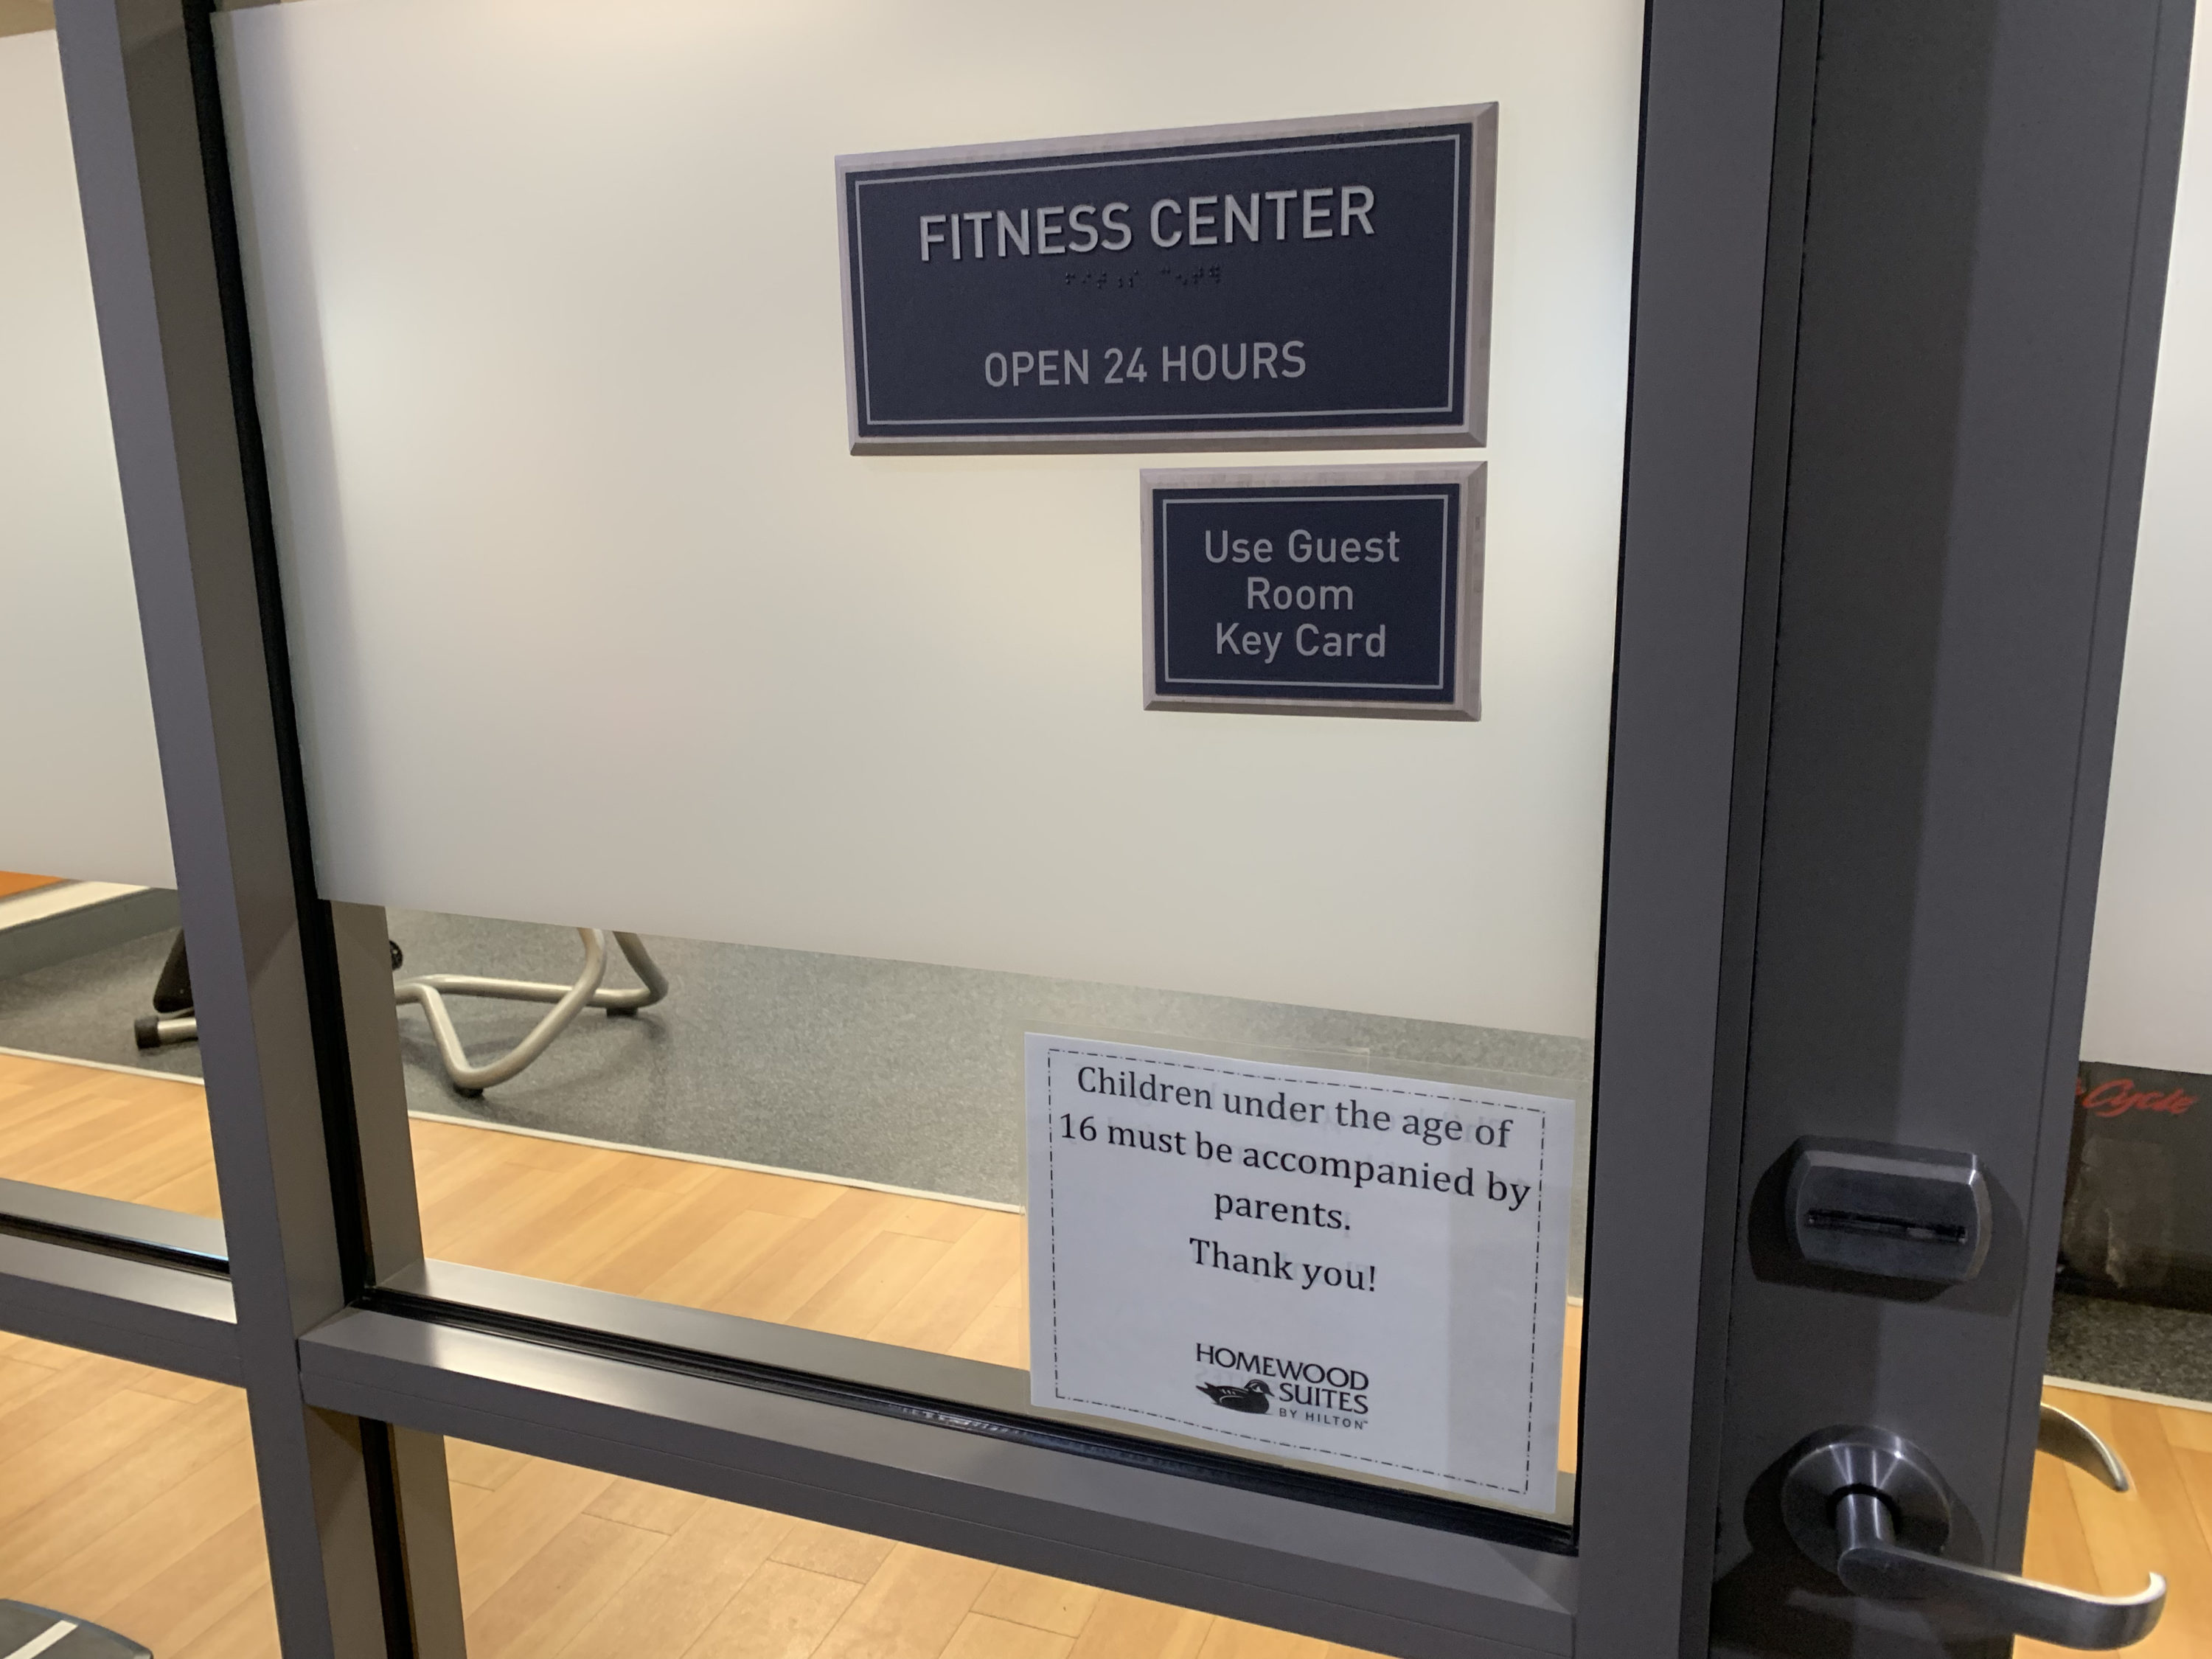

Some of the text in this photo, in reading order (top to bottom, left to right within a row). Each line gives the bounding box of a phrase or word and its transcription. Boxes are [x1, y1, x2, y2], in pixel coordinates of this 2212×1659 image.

[919, 184, 1377, 262] FITNESS CENTER
[984, 340, 1307, 387] OPEN 24 HOURS
[1205, 529, 1400, 563] Use Guest
[1247, 576, 1354, 611] Room
[1216, 622, 1386, 664] Key Card
[1077, 1065, 1514, 1149] Children under the age of
[1060, 1113, 1531, 1211] 16 must be accompanied by
[1214, 1191, 1351, 1231] parents.
[1189, 1238, 1376, 1293] Thank you!
[1196, 1343, 1369, 1391] HOMEWOOD
[1279, 1382, 1368, 1414] SUITES
[1279, 1408, 1363, 1430] BY HILTON
